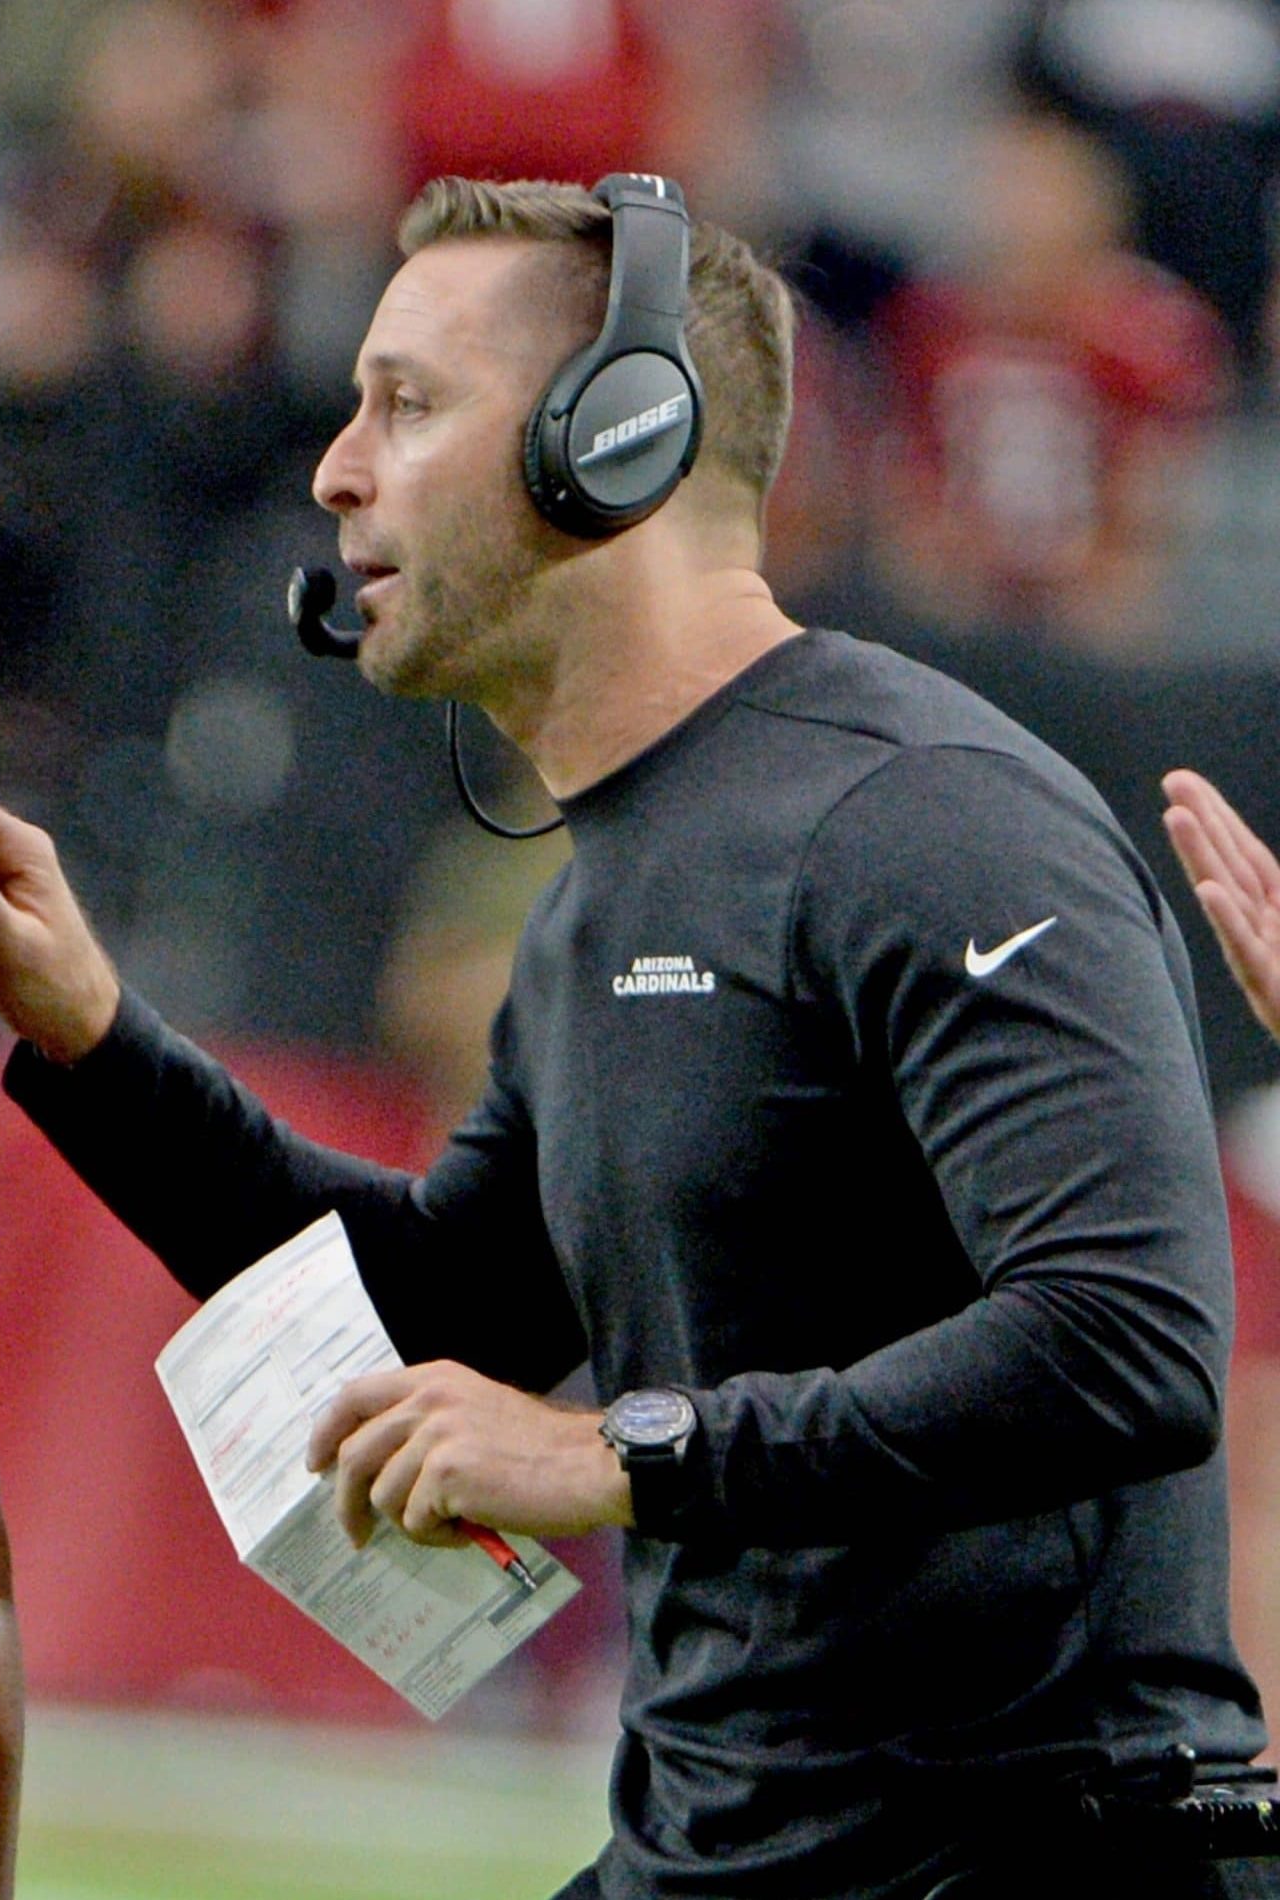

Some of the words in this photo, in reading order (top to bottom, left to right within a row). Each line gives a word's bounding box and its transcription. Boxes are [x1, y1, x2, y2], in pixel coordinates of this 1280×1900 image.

[581, 394, 685, 460] BOSE
[631, 955, 695, 972] ARIZONA
[612, 971, 716, 996] CARDINALS
